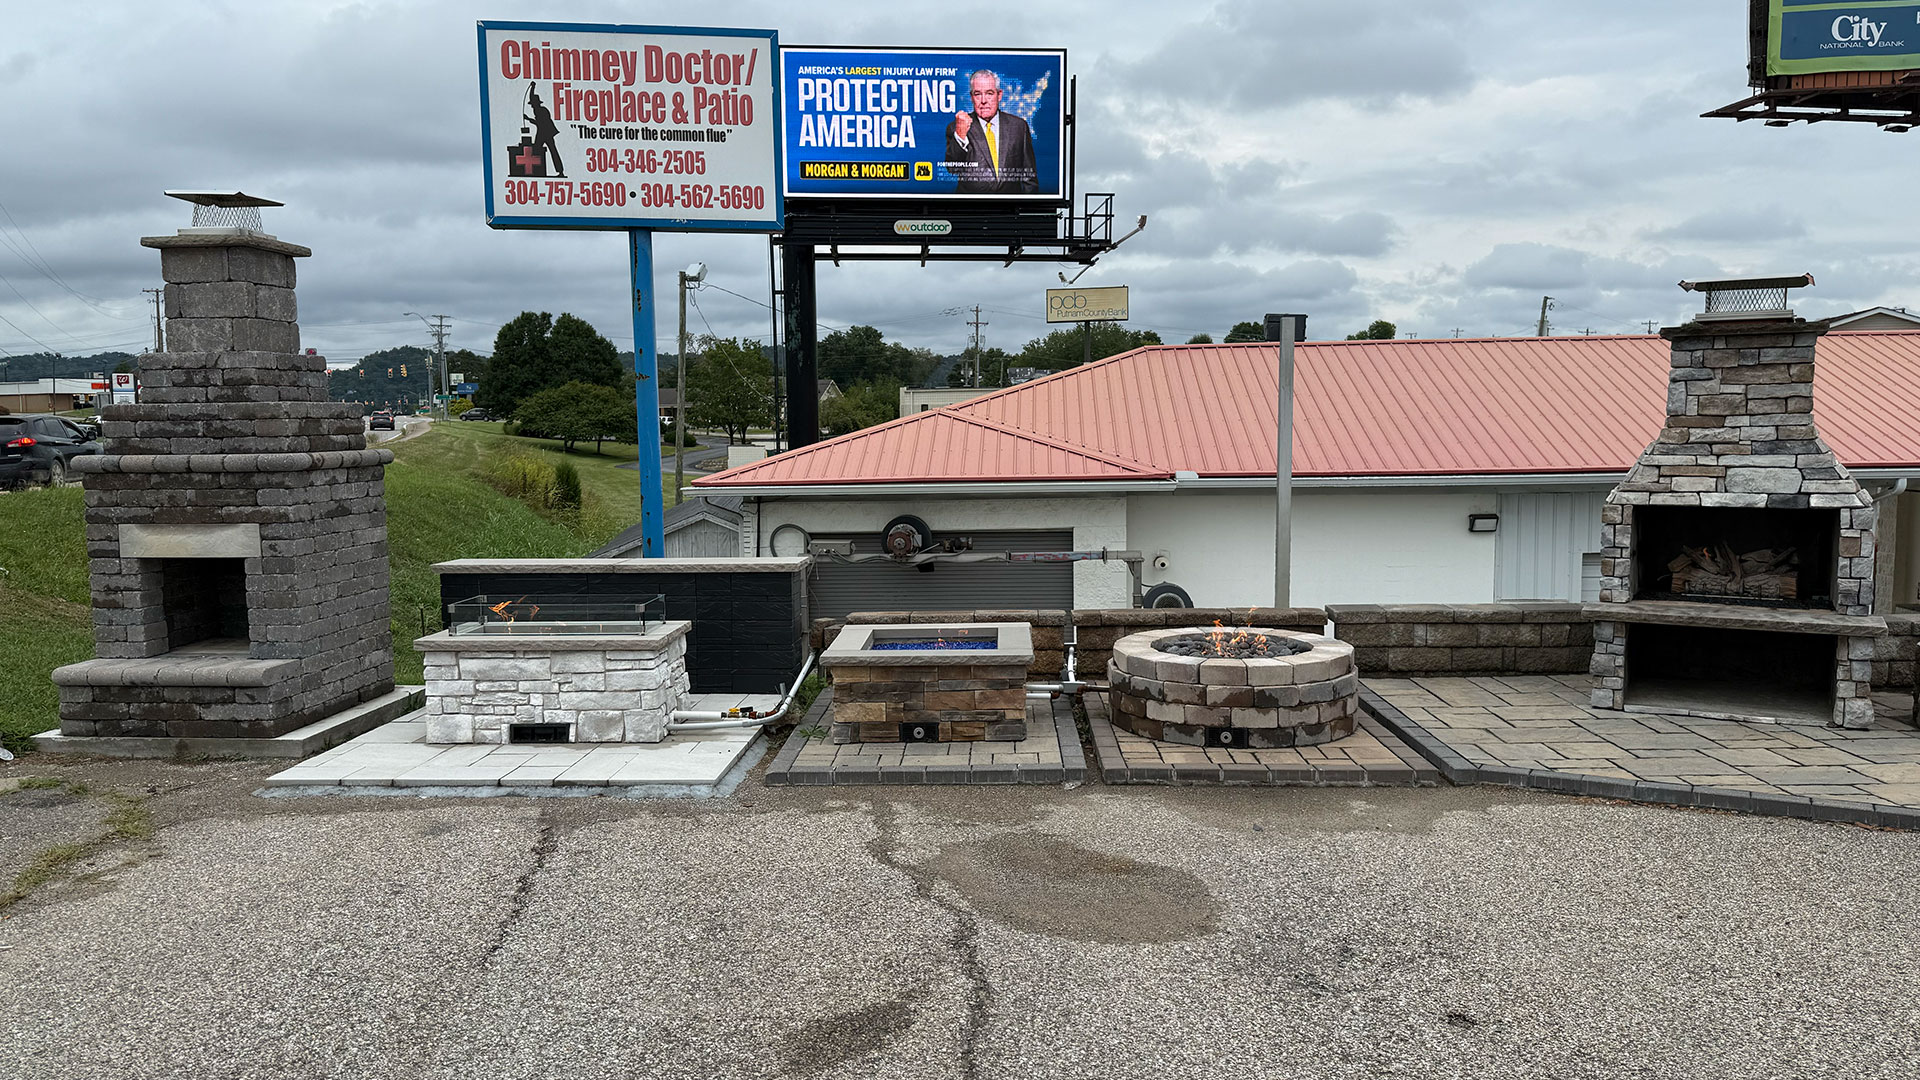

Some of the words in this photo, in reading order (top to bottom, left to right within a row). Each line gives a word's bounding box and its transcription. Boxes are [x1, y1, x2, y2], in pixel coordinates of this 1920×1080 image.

[1819, 42, 1864, 50] NATIONAL
[1878, 40, 1905, 48] BANK
[1831, 15, 1887, 47] City
[500, 39, 637, 86] Chimney
[644, 44, 758, 86] Doctor/
[798, 66, 844, 75] AMERICA'S
[844, 67, 882, 75] LARGEST
[883, 67, 914, 76] INJURY
[915, 68, 933, 76] LAW
[934, 68, 956, 76] FIRM
[552, 82, 667, 126] Fireplace
[671, 91, 689, 125] &
[693, 86, 754, 126] Patio
[798, 78, 956, 113] PROTECTING
[599, 127, 623, 139] cure
[624, 126, 640, 141] for
[641, 126, 659, 141] the
[660, 128, 705, 142] common
[798, 114, 916, 148] AMERICA
[586, 147, 706, 175] 304-346-2505
[805, 163, 850, 177] MORGAN
[851, 164, 858, 177] &
[861, 164, 904, 178] MORGAN
[504, 180, 627, 207] 304-757-5690
[641, 183, 765, 210] 304-562-5690
